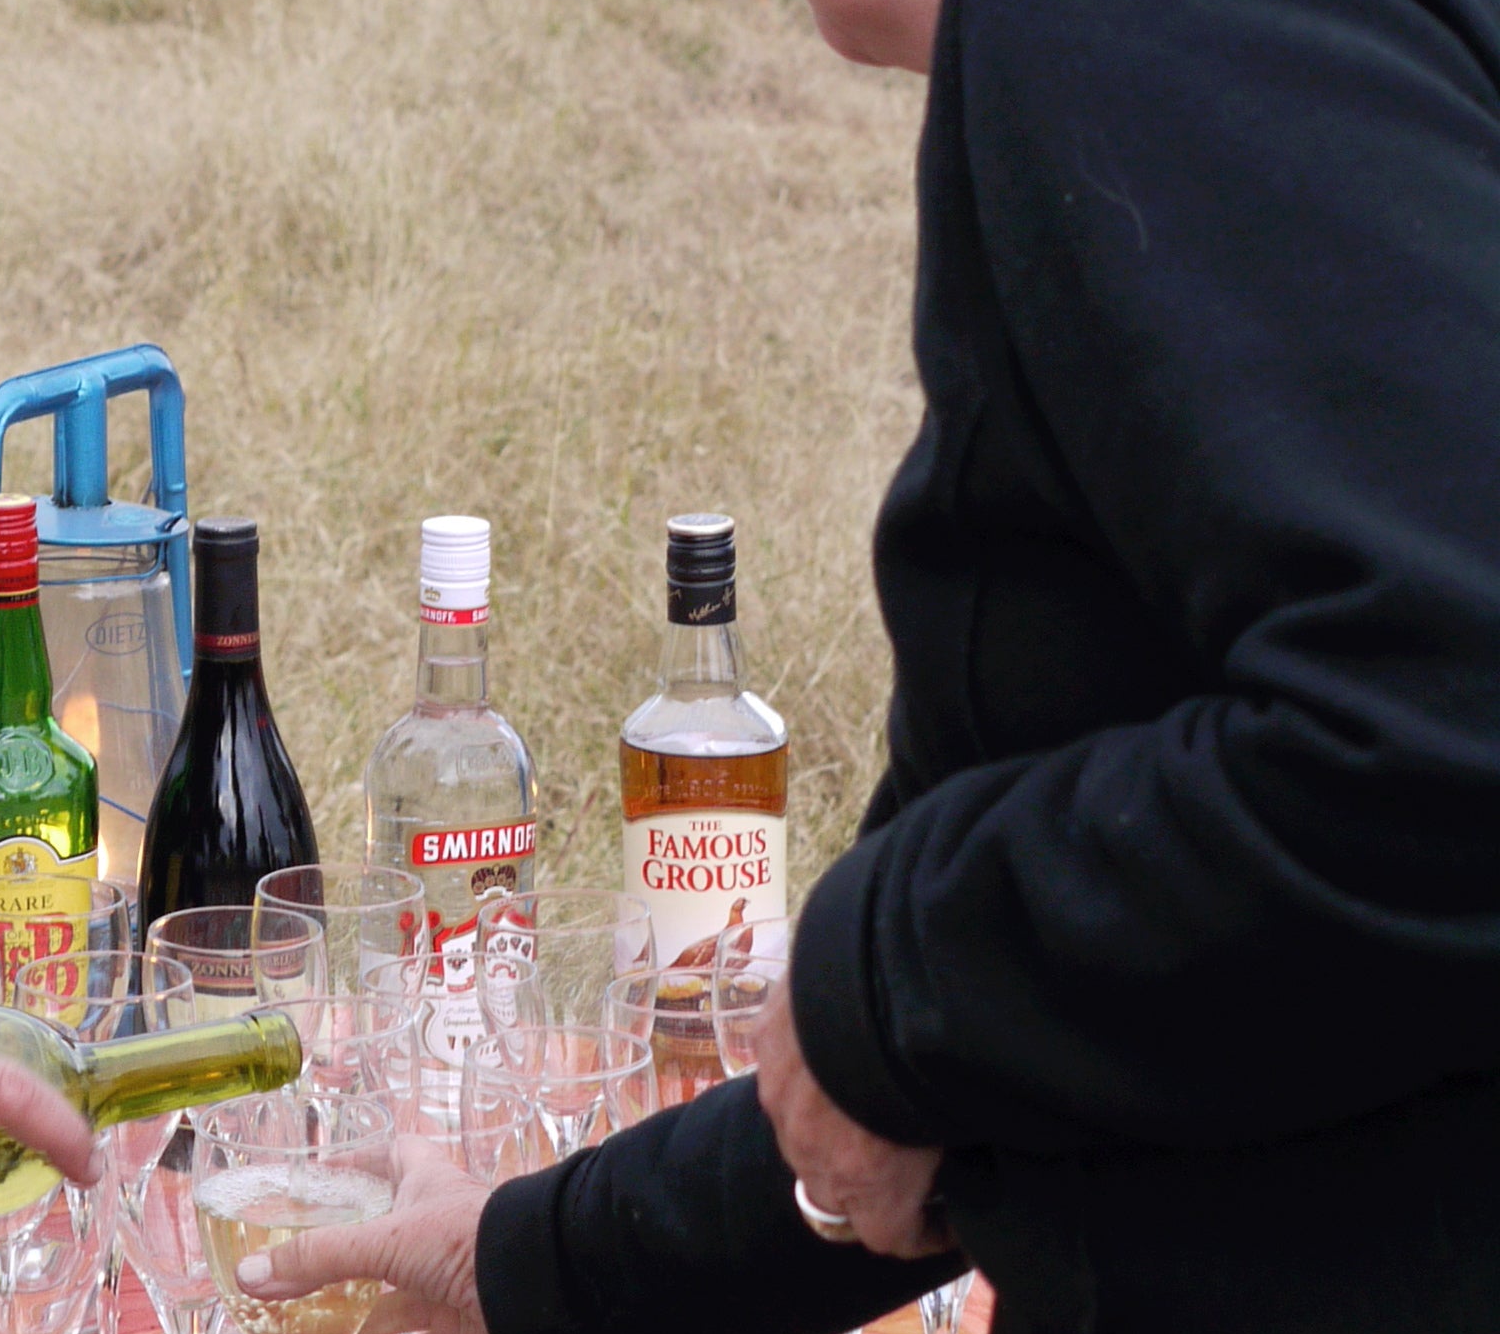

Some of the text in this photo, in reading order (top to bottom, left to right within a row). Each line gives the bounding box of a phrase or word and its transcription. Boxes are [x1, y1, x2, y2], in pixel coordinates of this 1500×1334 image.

[96, 622, 147, 645] DIETZ
[688, 820, 722, 832] THE
[647, 827, 767, 861] FAMOUS
[641, 856, 772, 893] GROUSE
